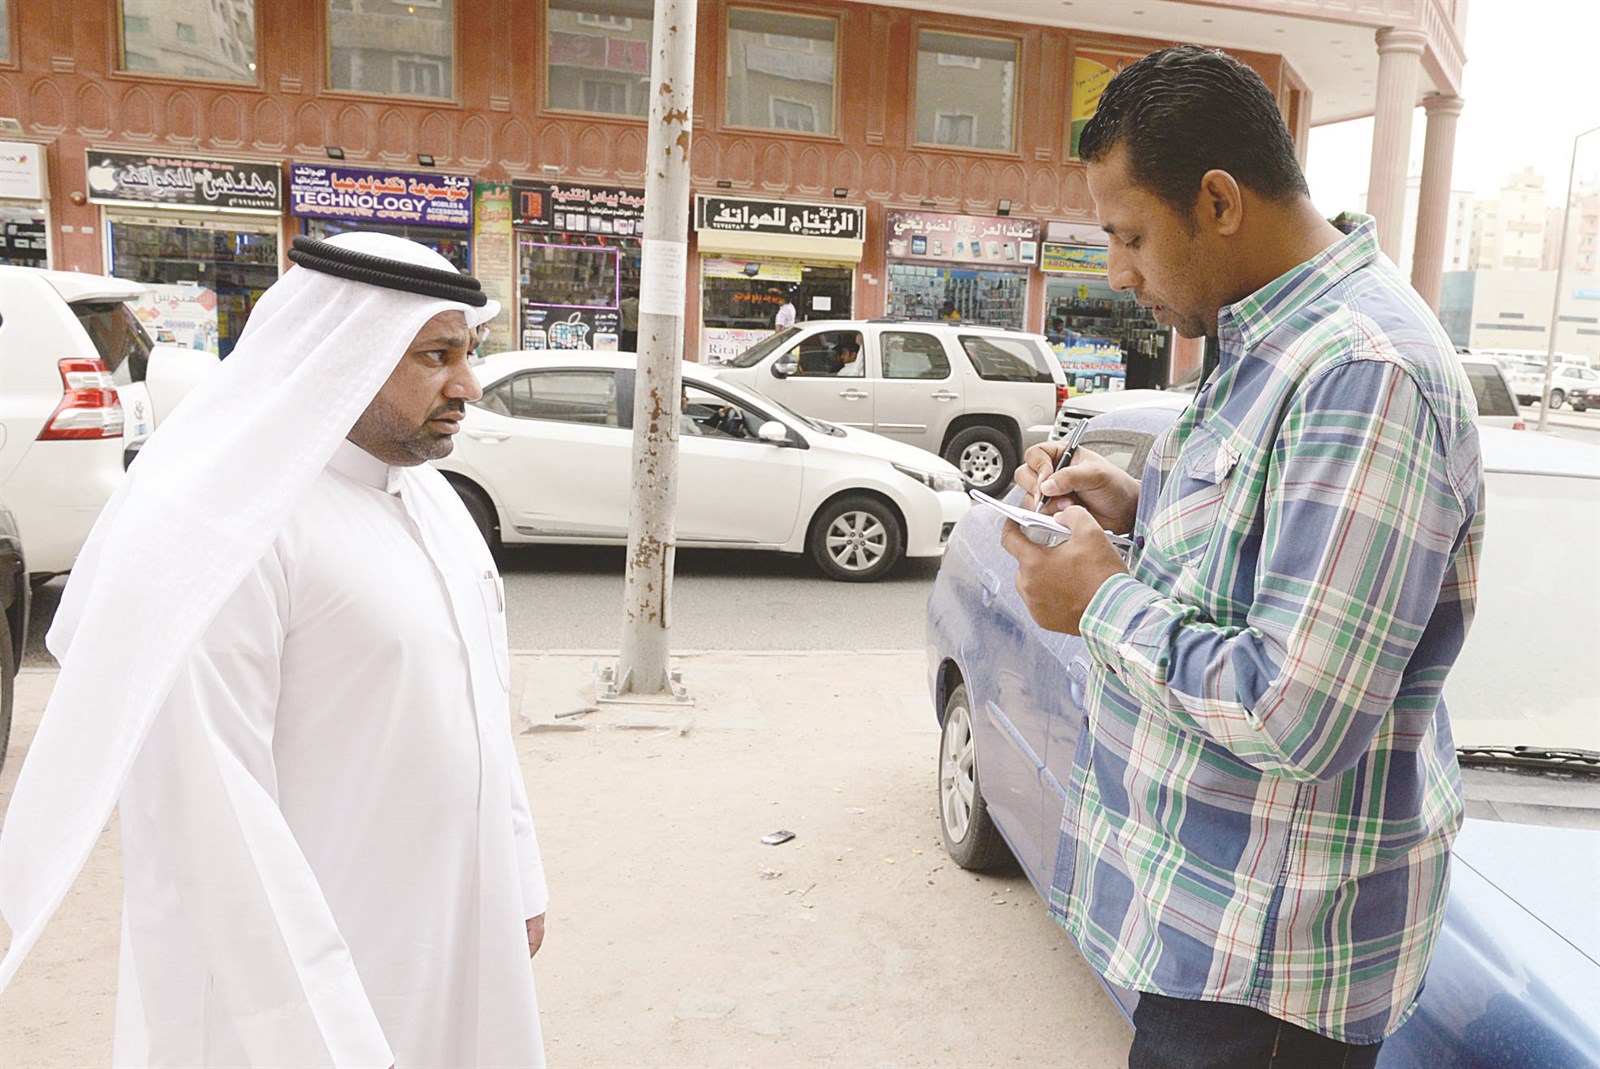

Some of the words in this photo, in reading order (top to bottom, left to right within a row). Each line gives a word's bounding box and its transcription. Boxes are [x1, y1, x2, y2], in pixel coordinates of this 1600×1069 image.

[330, 172, 407, 196] تكنولوجيا
[408, 177, 469, 202] موسوعة
[443, 175, 470, 187] شركة
[292, 190, 426, 212] TECHNOLOGY
[819, 207, 838, 218] شركة
[713, 203, 786, 229] للهواتف
[789, 210, 854, 234] الريتاج
[708, 344, 739, 356] Ritaj
